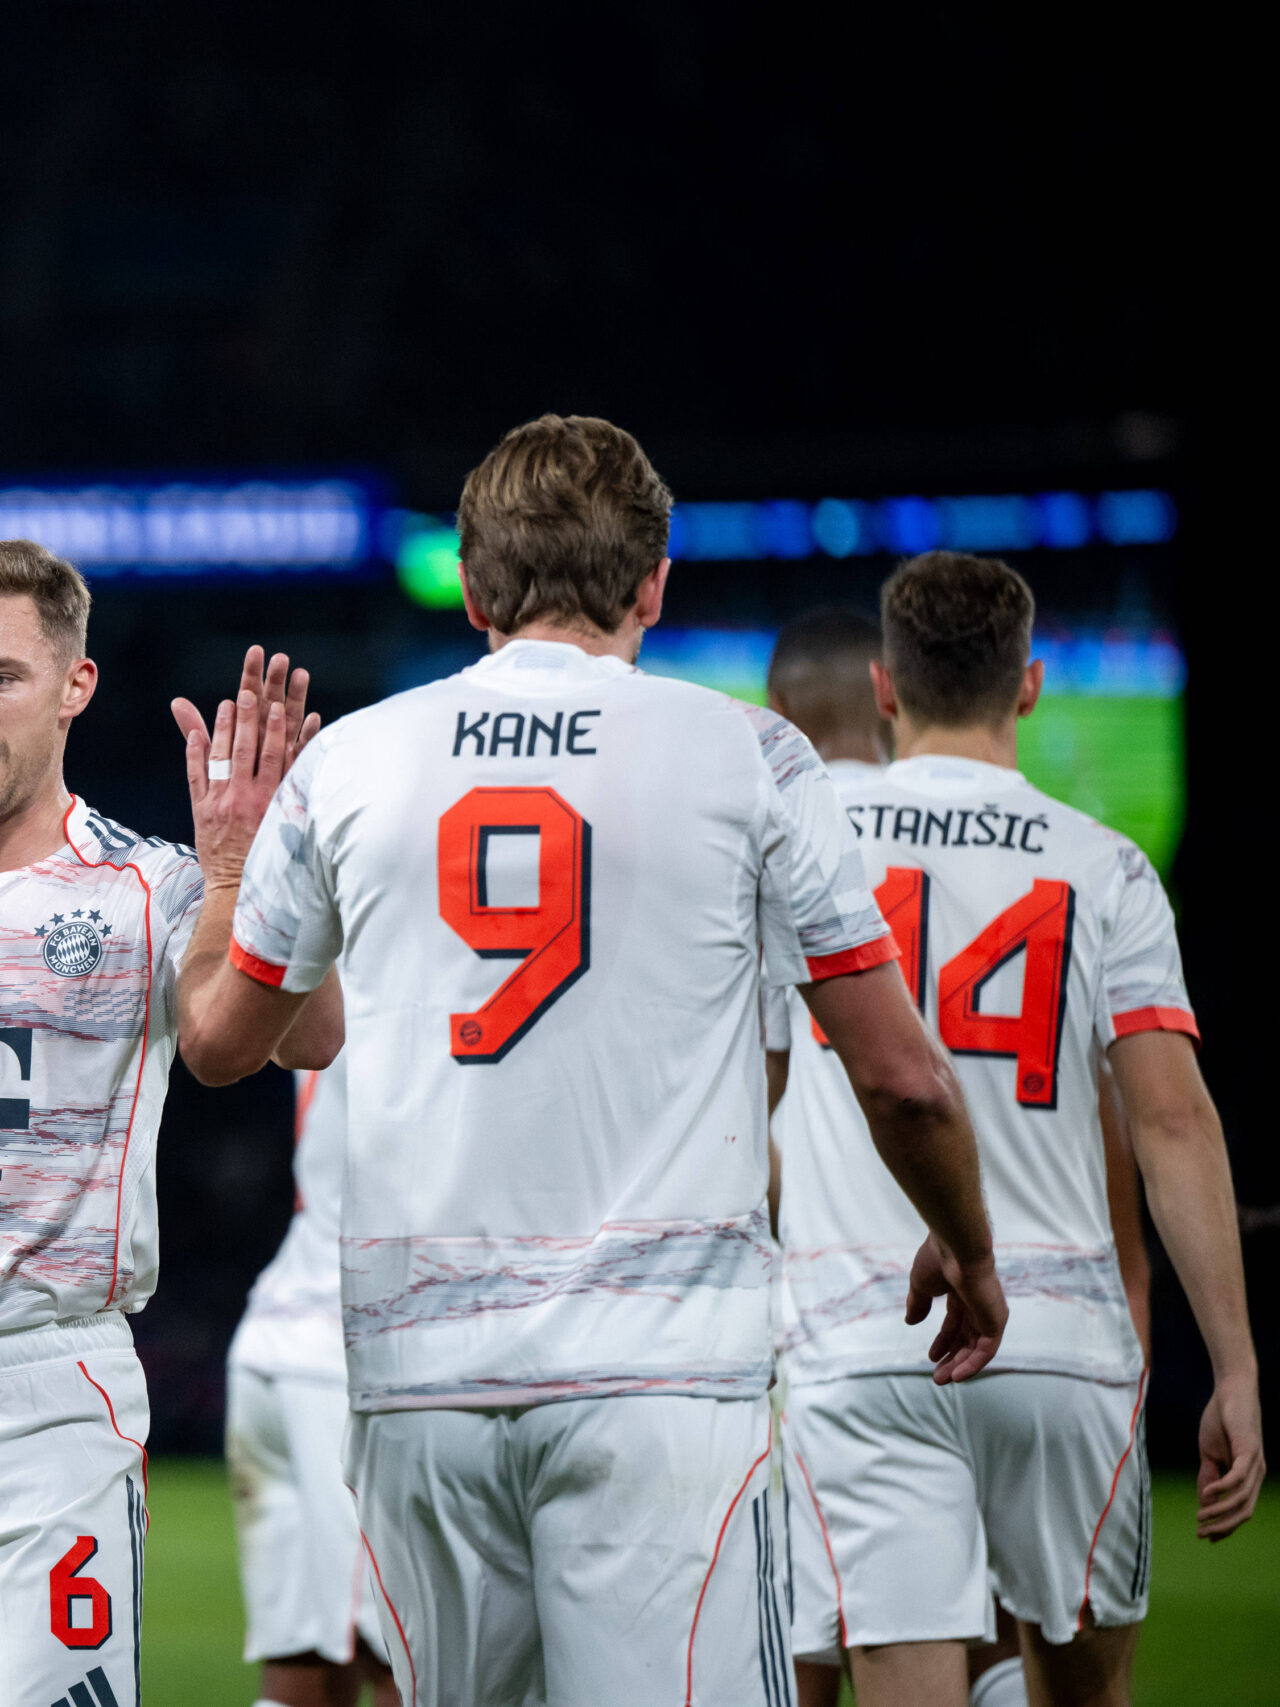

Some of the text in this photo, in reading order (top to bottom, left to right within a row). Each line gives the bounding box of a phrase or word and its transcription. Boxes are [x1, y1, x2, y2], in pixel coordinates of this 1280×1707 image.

[452, 710, 601, 757] KANE
[49, 925, 98, 947] FC BAYERN
[437, 786, 592, 1065] 9
[49, 1536, 112, 1650] 6
